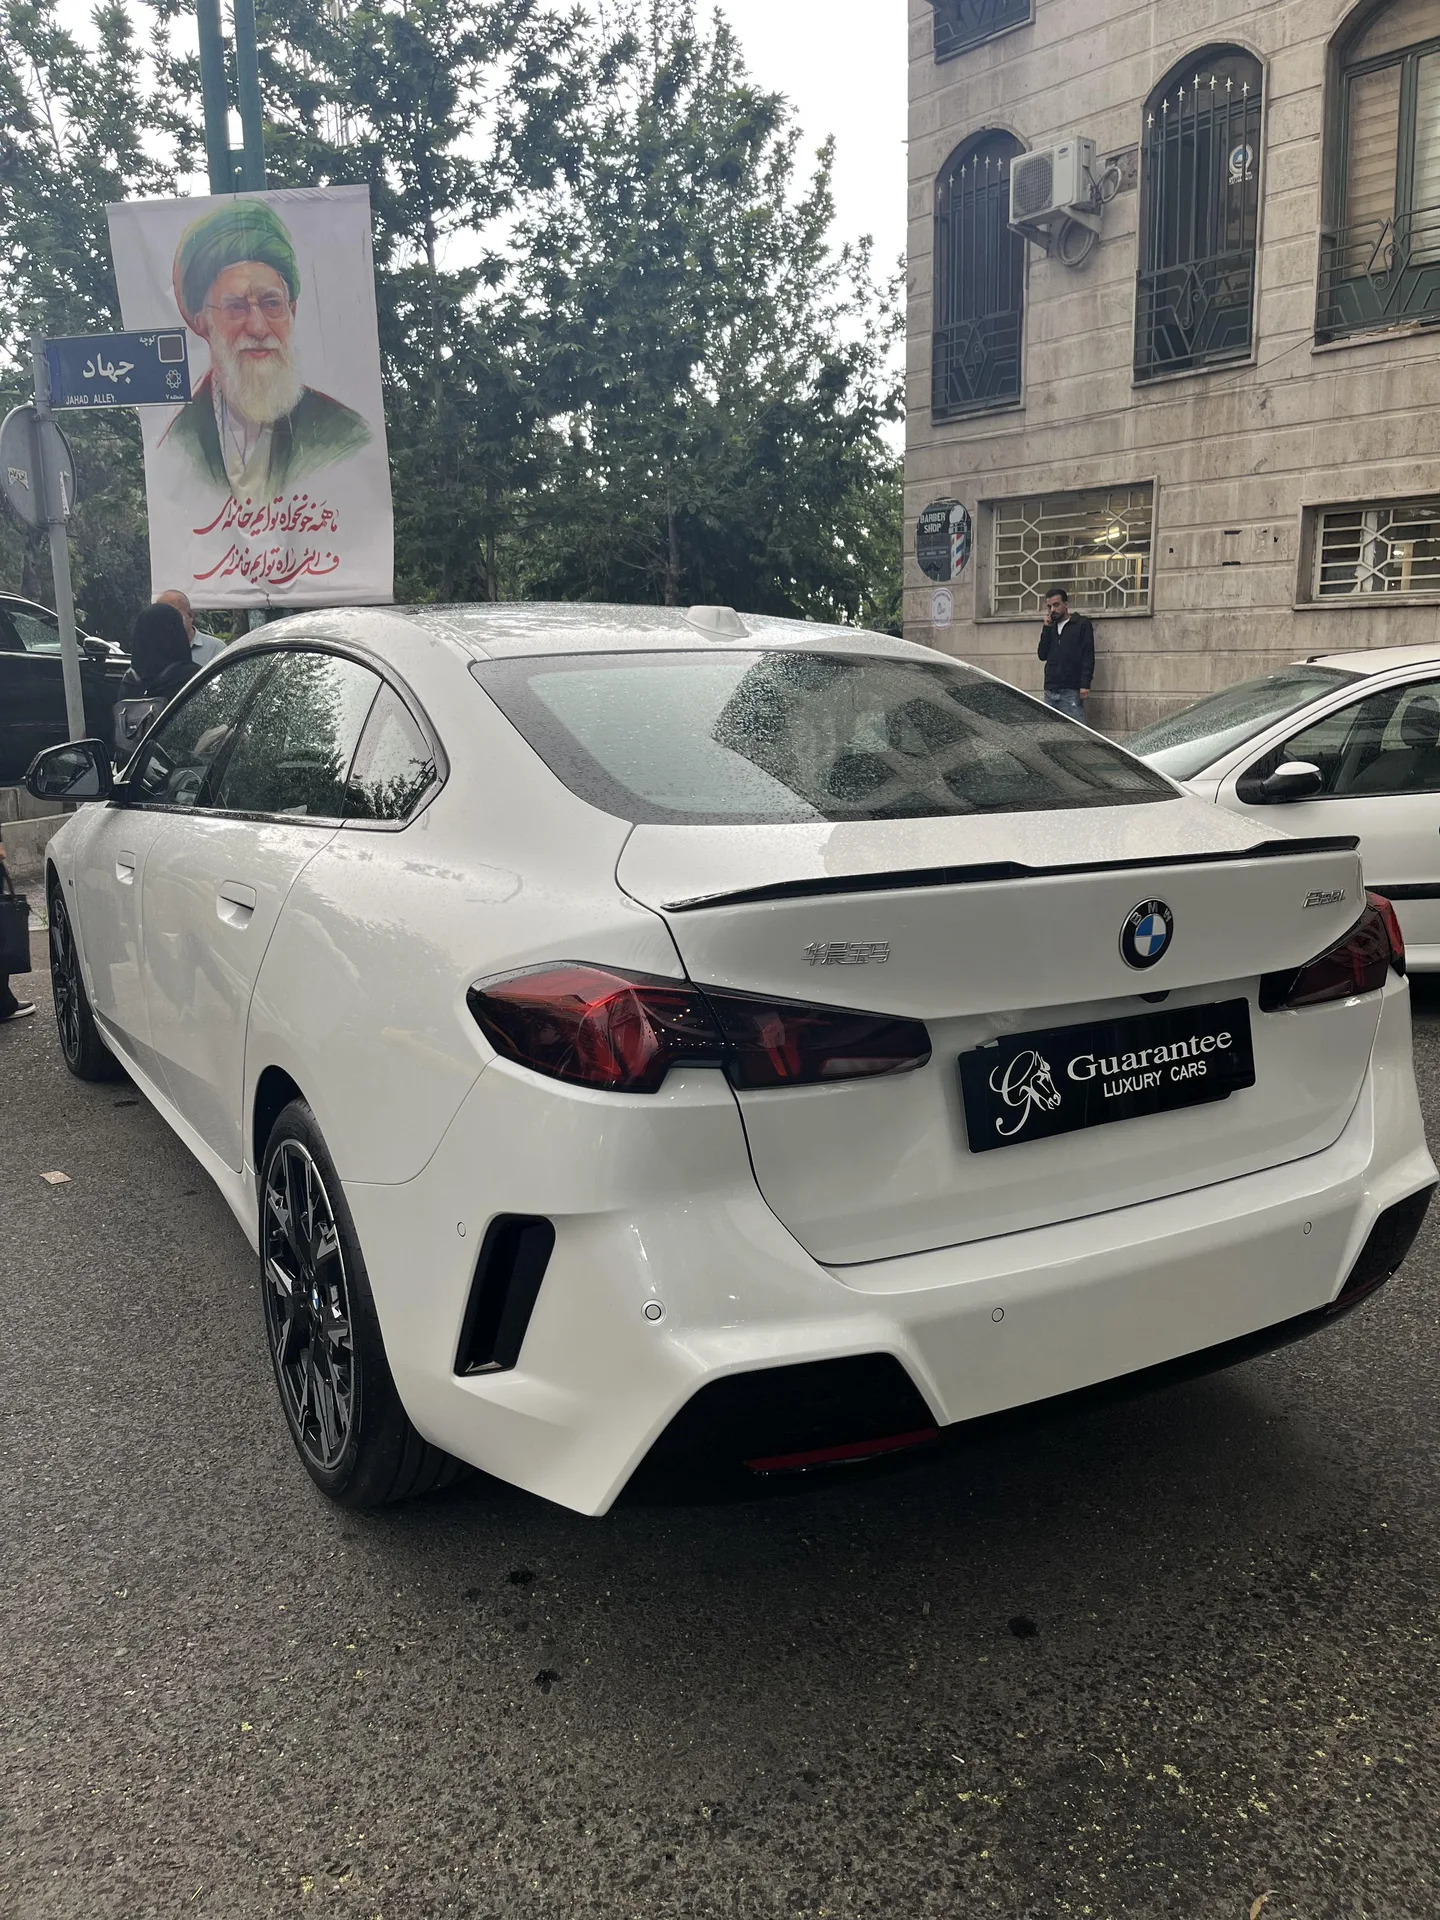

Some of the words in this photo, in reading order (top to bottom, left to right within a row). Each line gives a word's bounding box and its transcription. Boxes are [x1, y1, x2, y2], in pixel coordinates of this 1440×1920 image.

[139, 335, 157, 346] کوچه
[82, 352, 135, 384] جهاد
[65, 394, 89, 405] JAHAD
[306, 501, 334, 532] همه
[330, 508, 340, 532] ما
[920, 511, 946, 524] BARBER
[923, 523, 942, 534] SHOP
[1129, 901, 1172, 926] BMW
[801, 940, 890, 966] 华晨宝马
[1066, 1031, 1233, 1081] Guarantee
[1103, 1070, 1163, 1098] LUXURY
[1170, 1060, 1207, 1082] CARS
